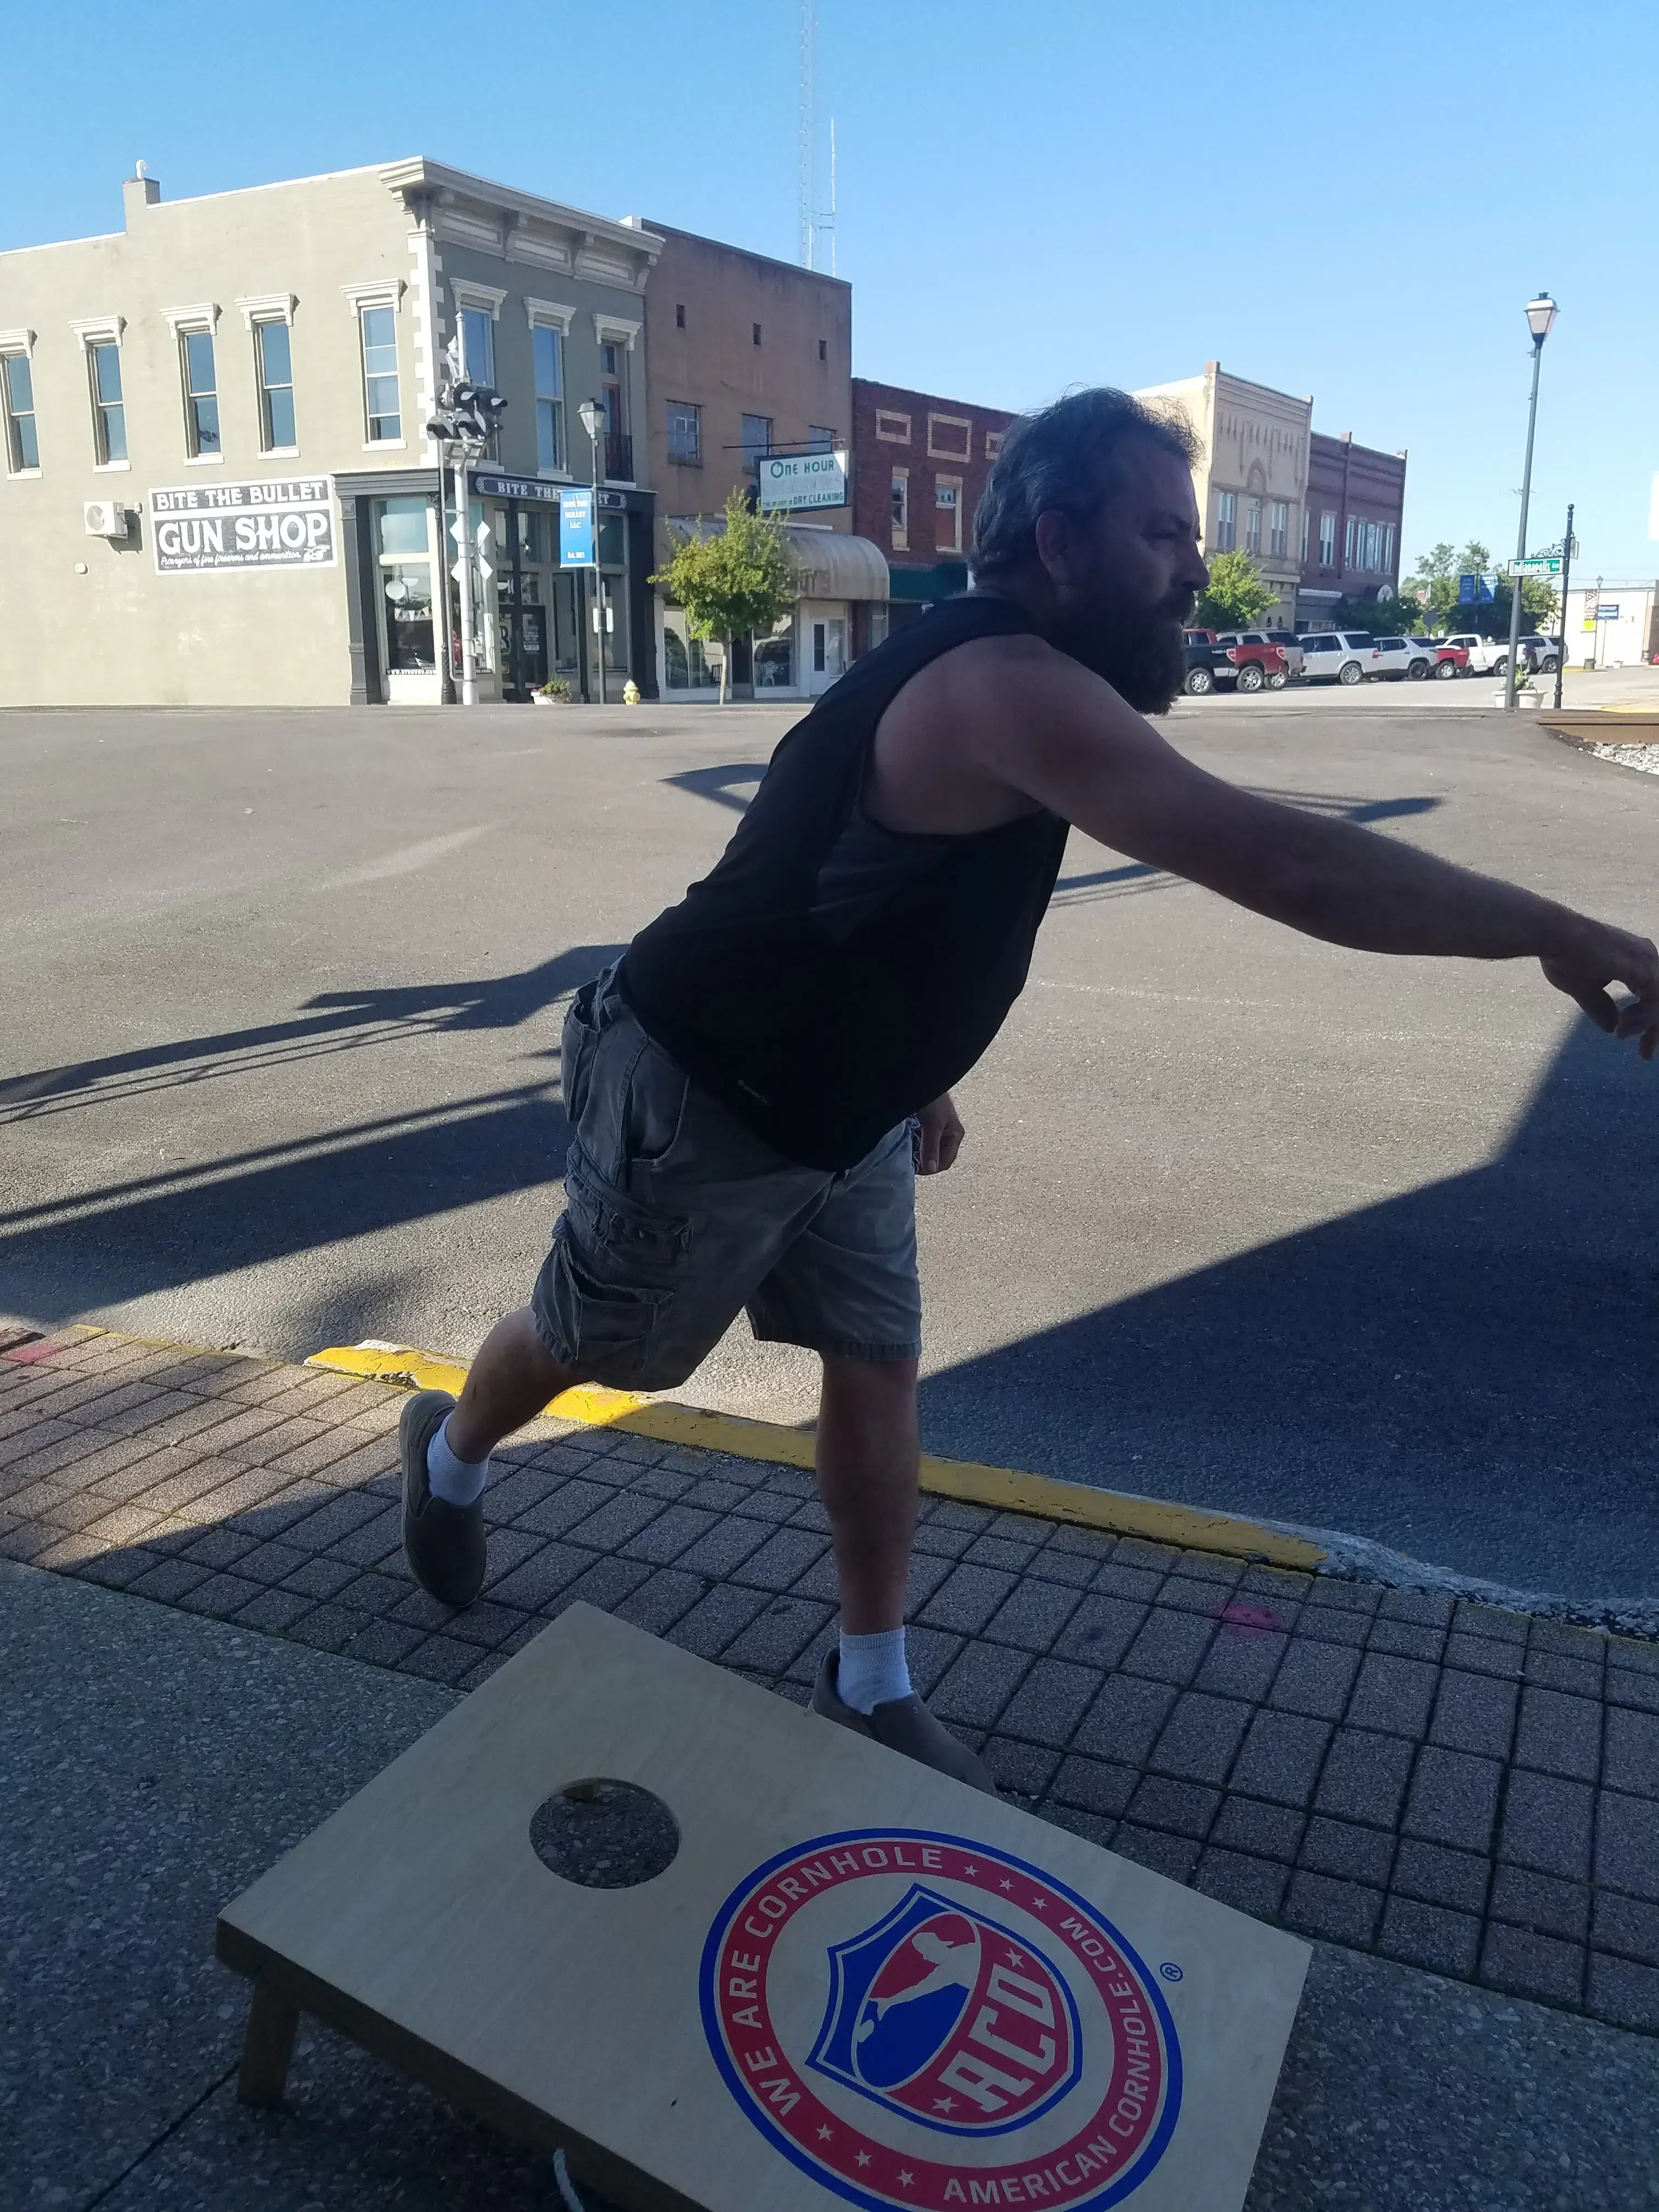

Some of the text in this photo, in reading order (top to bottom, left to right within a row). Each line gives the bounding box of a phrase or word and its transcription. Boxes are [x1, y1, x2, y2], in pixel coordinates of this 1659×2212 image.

[804, 460, 834, 473] HOUR
[156, 482, 323, 510] BITE THE BULLET
[498, 482, 560, 499] BITE THE
[793, 495, 806, 505] DRY
[808, 492, 844, 504] CLEANING
[159, 512, 328, 555] GUN SHOP
[193, 554, 200, 567] of
[200, 554, 214, 566] fine
[245, 551, 259, 561] and
[1511, 560, 1551, 574] Indianapolis
[729, 1846, 943, 2117] WE ARE CORNHOLE
[938, 1962, 1055, 2113] ACO
[943, 1917, 1151, 2204] AMERICAN CORNHOLE.COM
